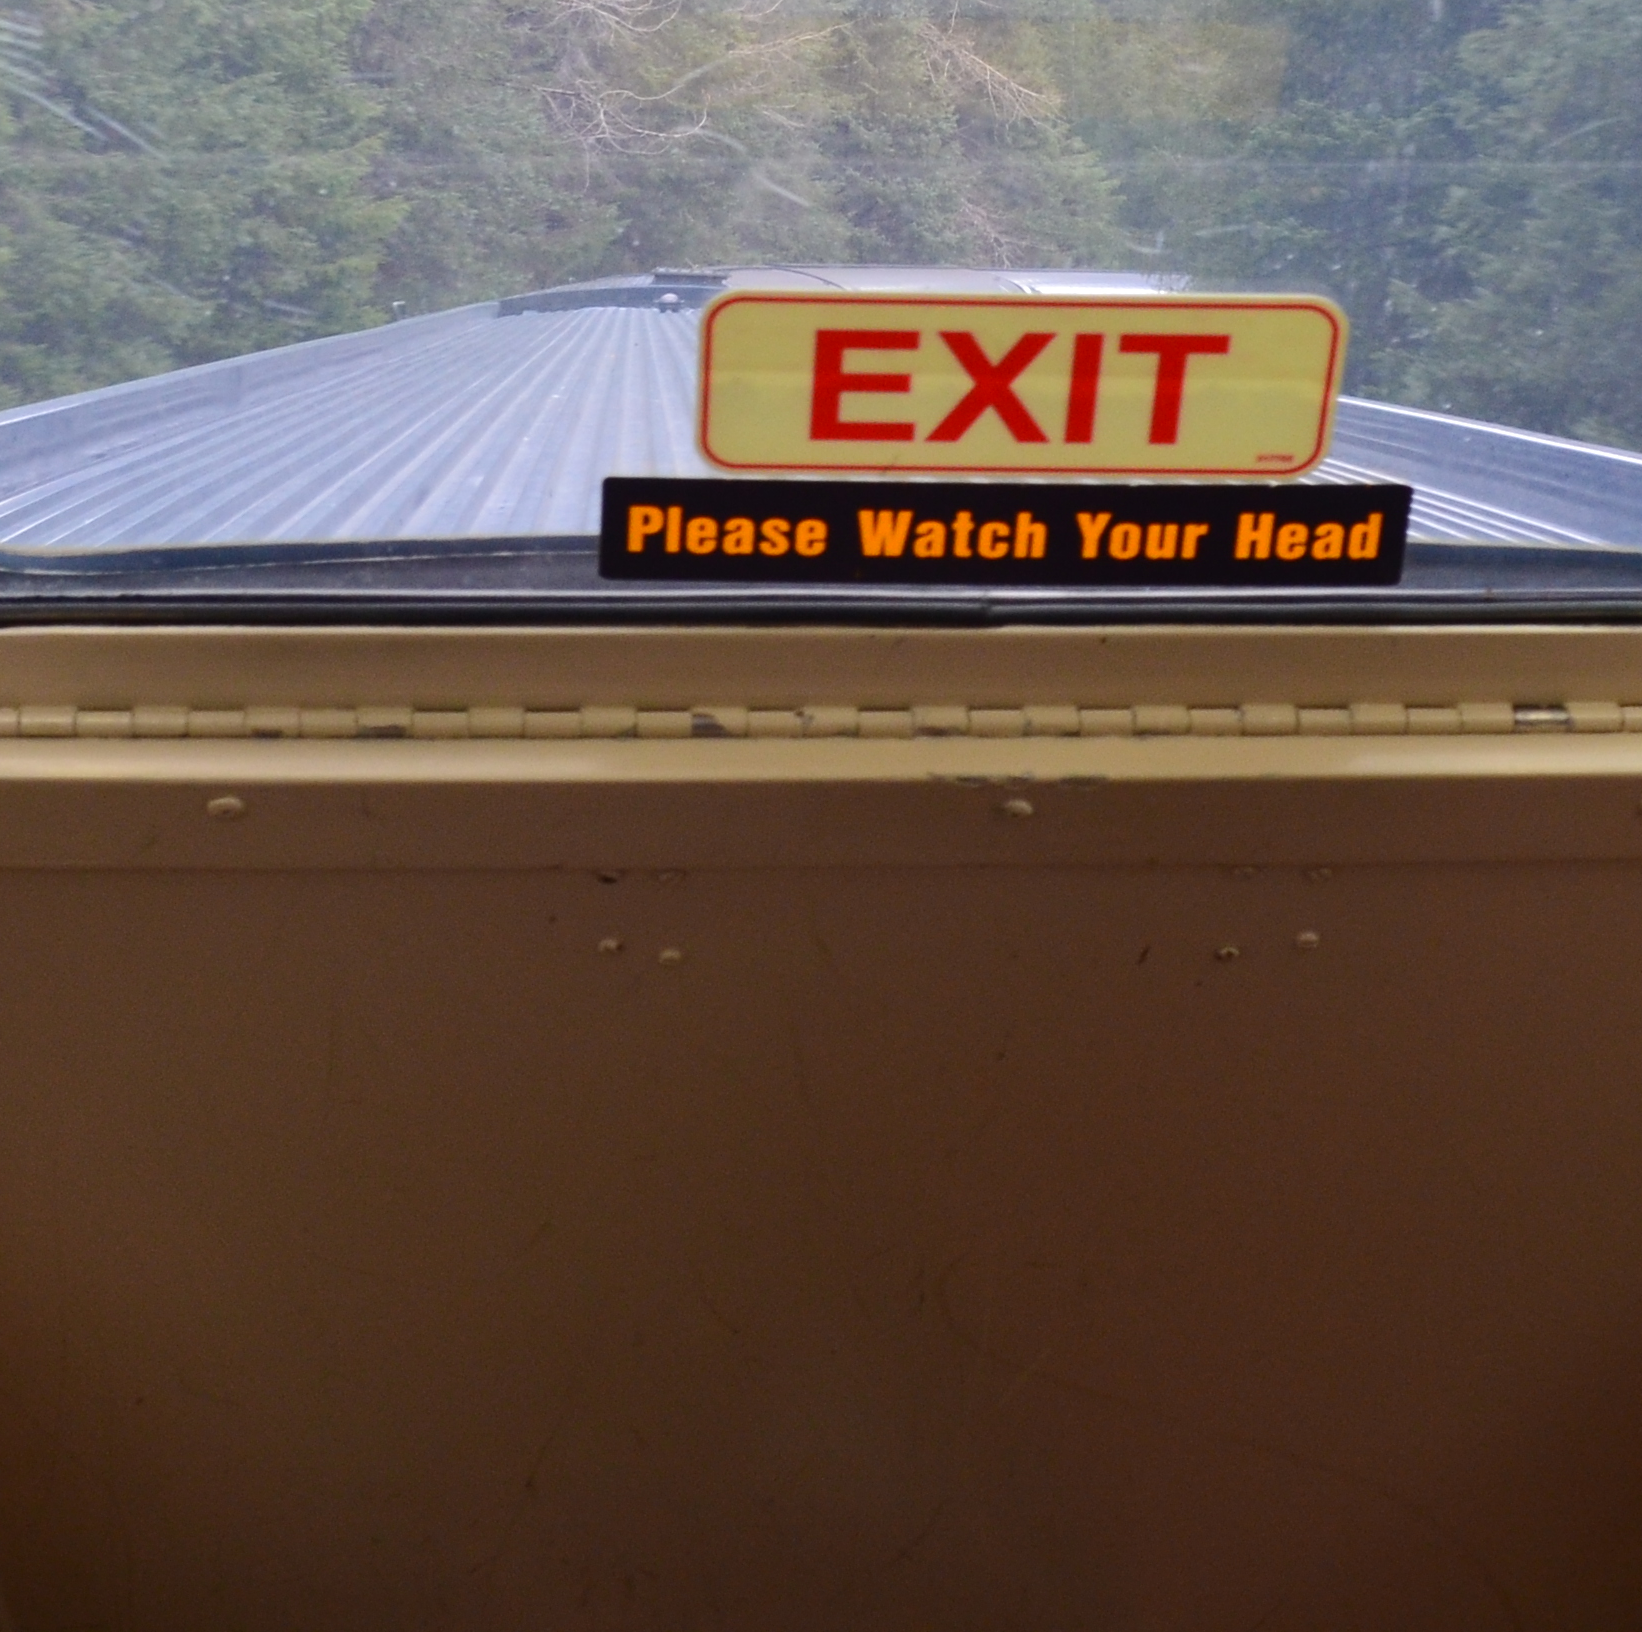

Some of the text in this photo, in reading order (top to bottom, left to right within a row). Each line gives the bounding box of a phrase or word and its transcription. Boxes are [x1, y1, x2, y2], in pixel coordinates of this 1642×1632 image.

[808, 328, 1232, 446] EXIT
[626, 504, 1383, 561] Please Watch Your Head
